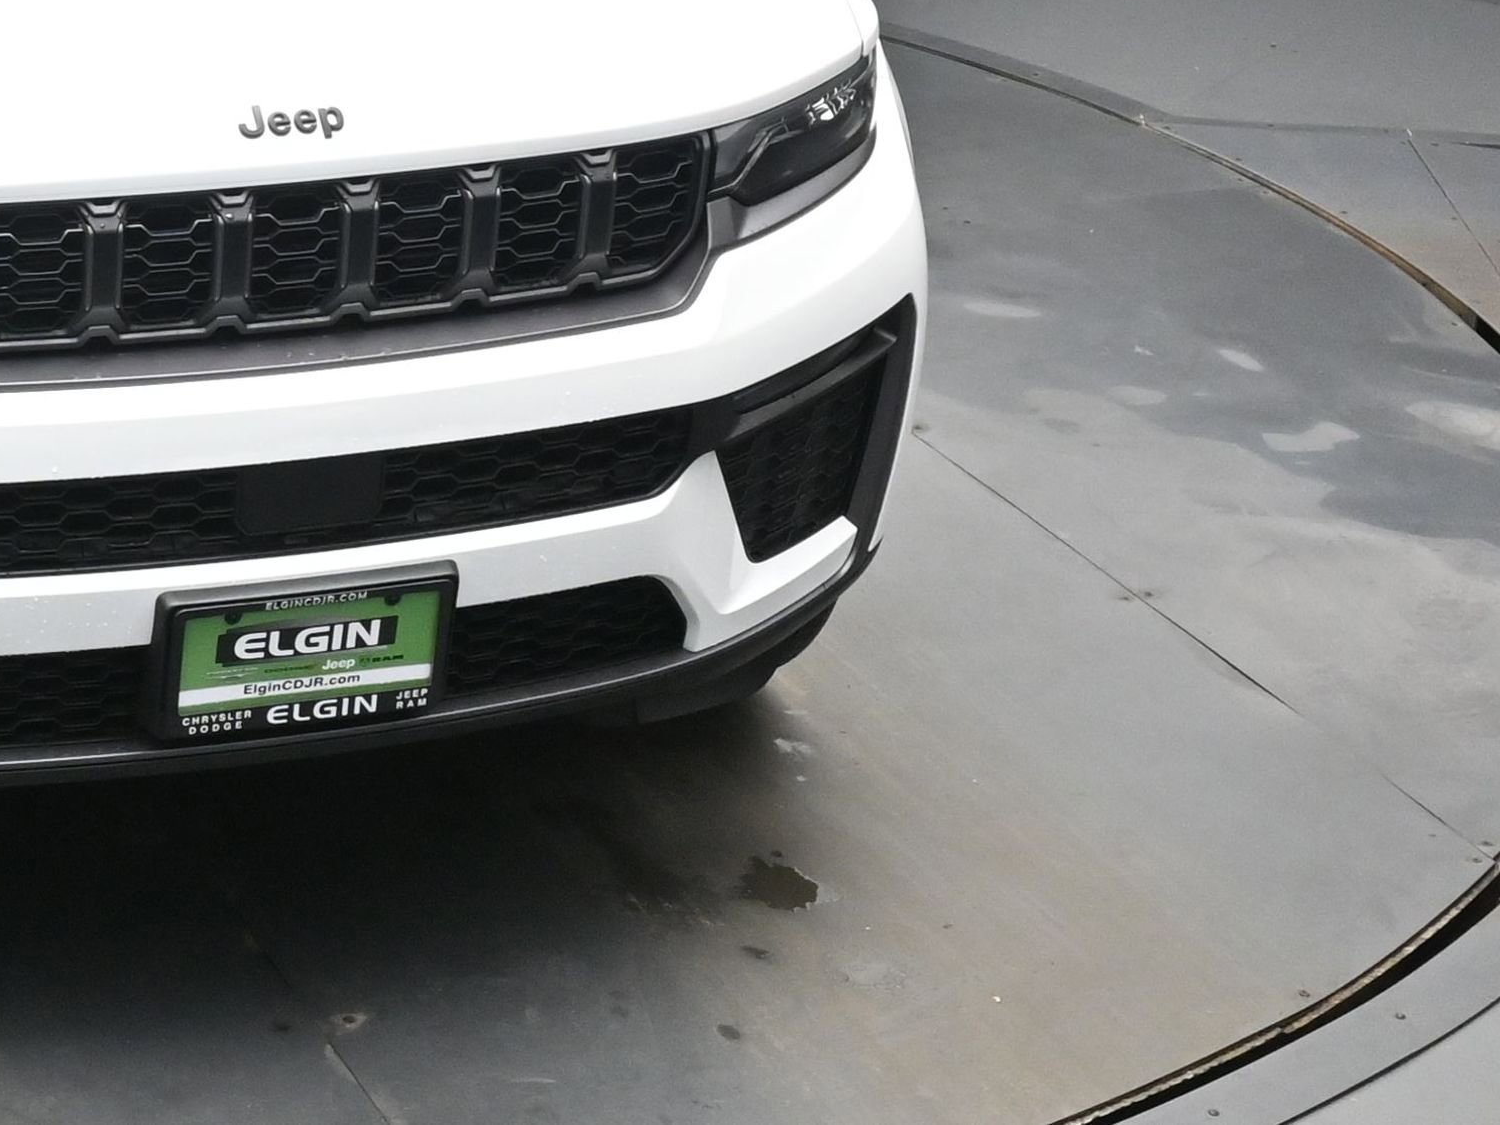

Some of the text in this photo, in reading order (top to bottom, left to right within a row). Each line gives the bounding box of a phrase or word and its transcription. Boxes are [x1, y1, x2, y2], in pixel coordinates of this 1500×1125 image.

[238, 105, 344, 139] Jeep
[265, 591, 368, 611] ELGINCDJR.COM
[234, 619, 381, 660] ELGIN
[322, 657, 355, 671] Jeep
[243, 673, 360, 696] ElginCDJR.com
[396, 688, 429, 700] JEEP
[267, 694, 378, 725] ELGIN
[395, 698, 428, 709] RAM
[182, 710, 252, 727] CHRYSLER
[188, 721, 242, 735] DODGE
